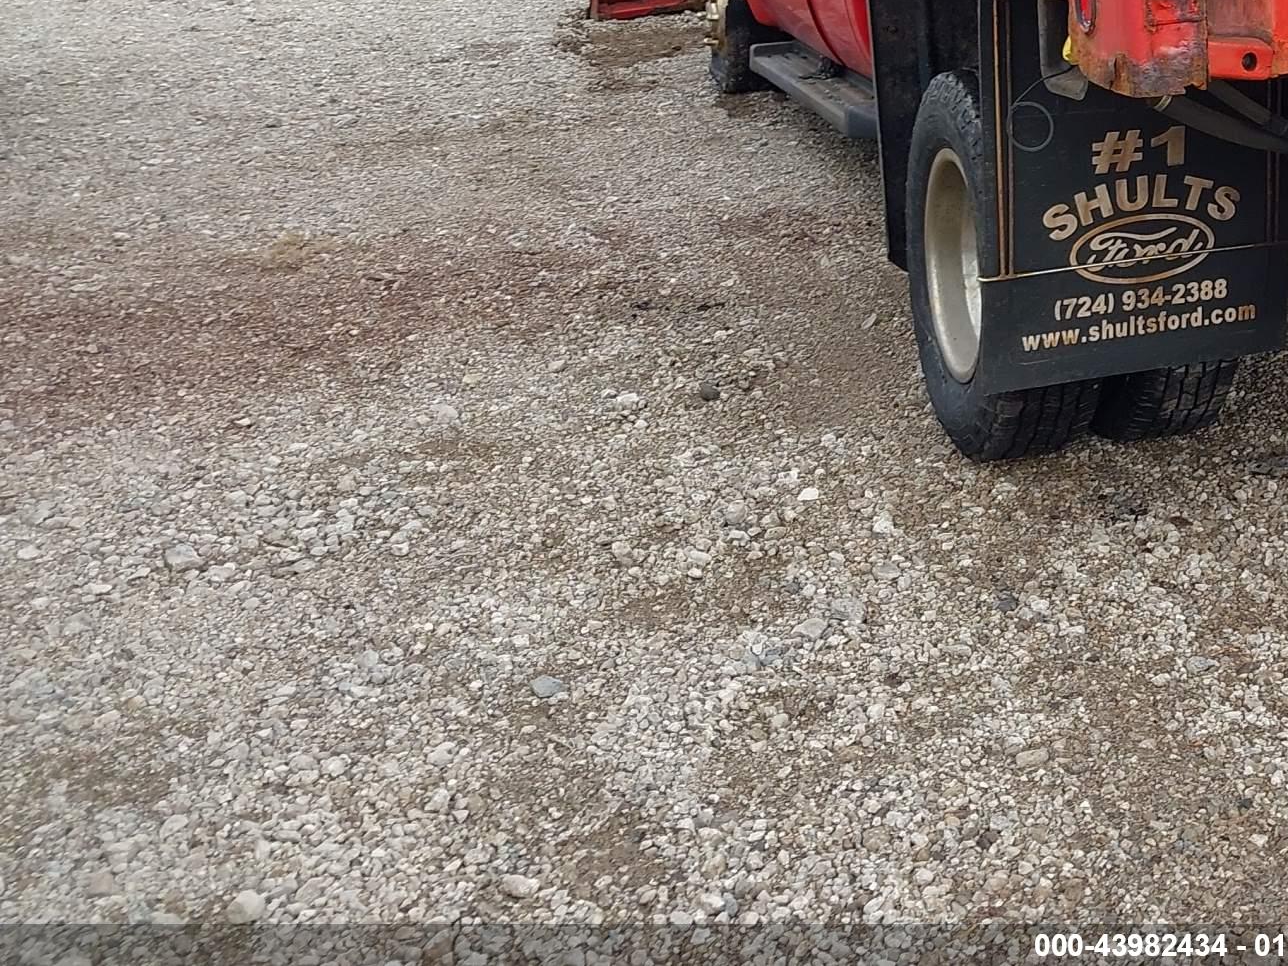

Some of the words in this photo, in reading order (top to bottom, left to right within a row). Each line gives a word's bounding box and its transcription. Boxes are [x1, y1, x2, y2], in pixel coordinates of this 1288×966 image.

[1091, 125, 1186, 174] #1
[1042, 174, 1241, 241] SHULTS
[1086, 226, 1203, 272] Ford
[1054, 292, 1115, 321] (724)
[1122, 278, 1228, 312] 934-2388
[1022, 302, 1256, 352] www.shultsford.com
